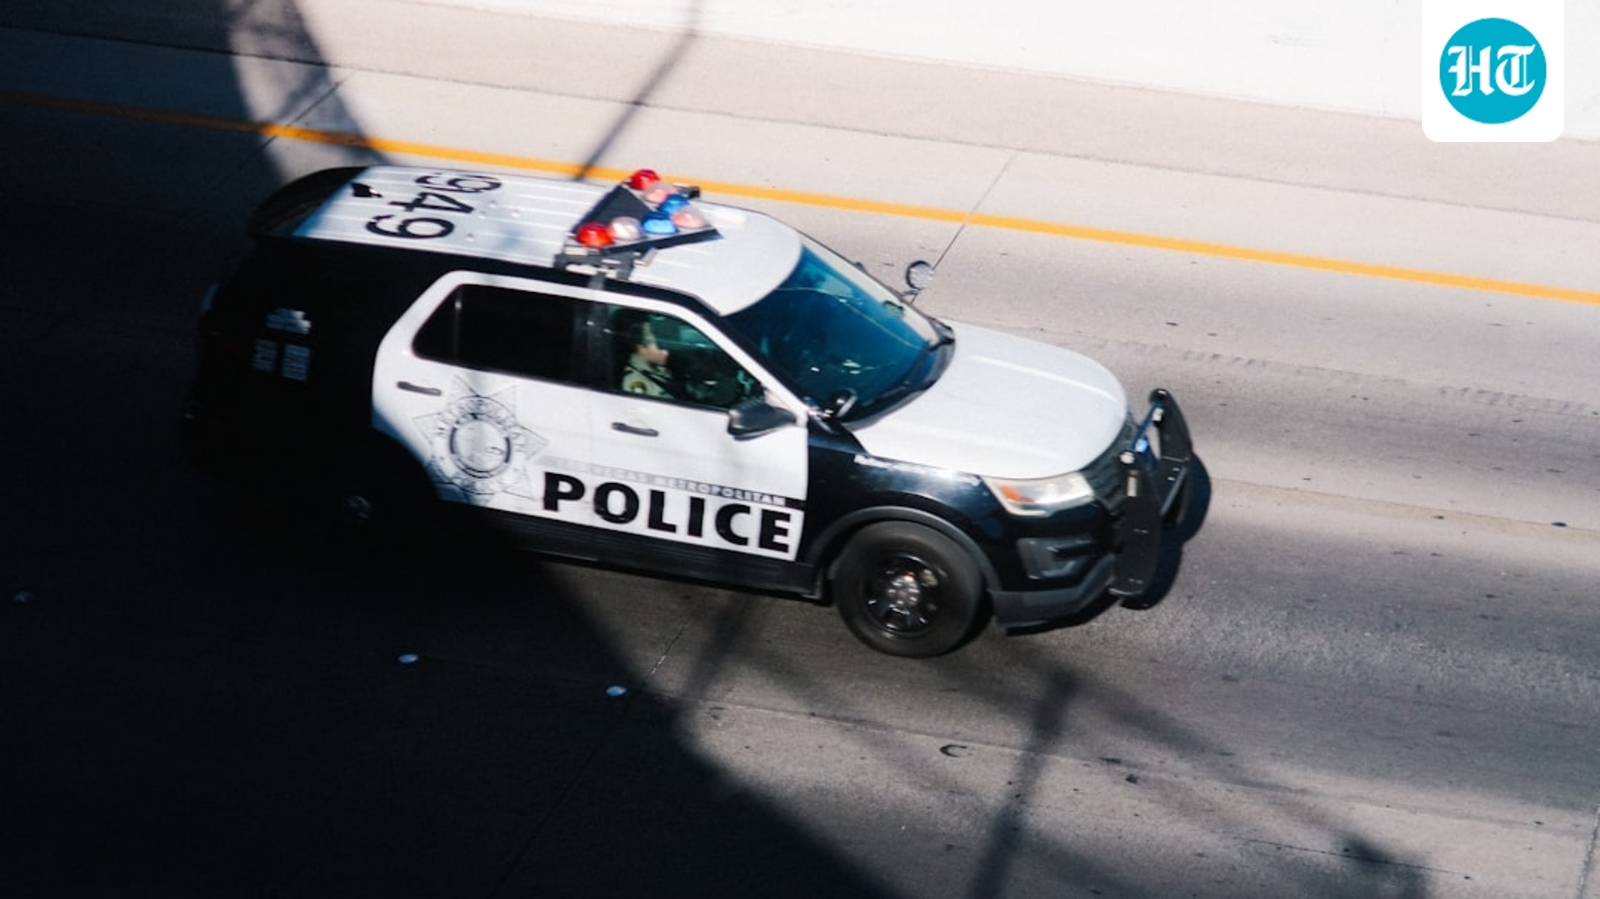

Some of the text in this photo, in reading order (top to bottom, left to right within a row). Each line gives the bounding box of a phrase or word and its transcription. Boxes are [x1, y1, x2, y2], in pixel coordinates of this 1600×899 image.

[365, 173, 502, 239] 949
[542, 471, 792, 553] POLICE
[654, 475, 786, 506] METROPOLITAN
